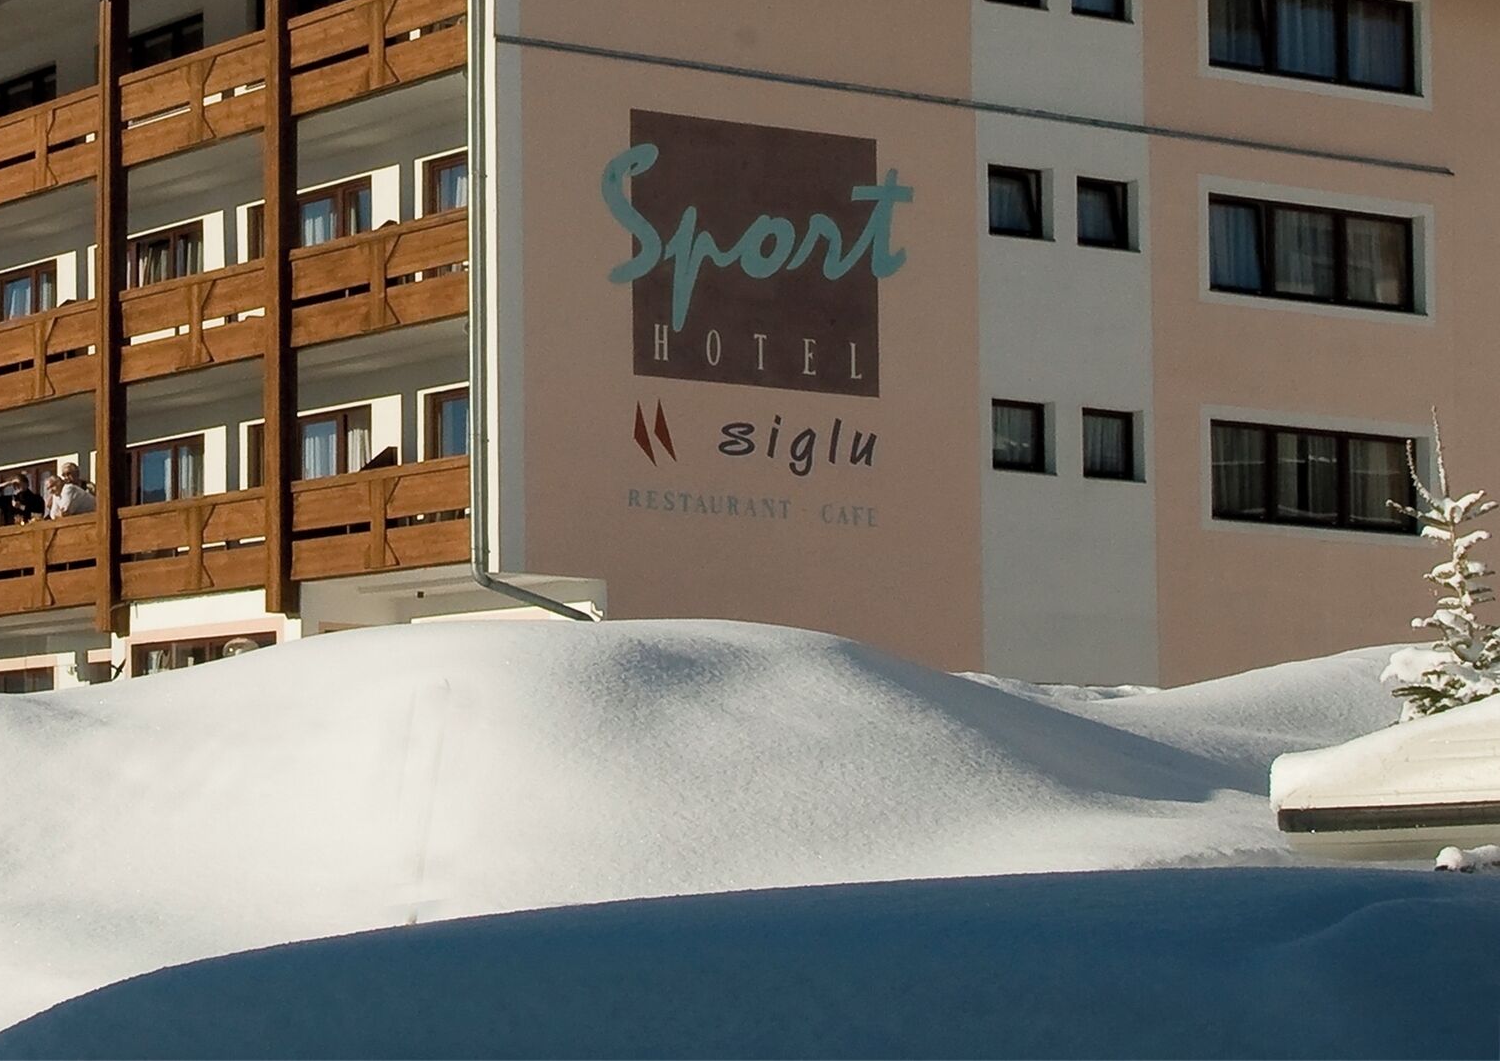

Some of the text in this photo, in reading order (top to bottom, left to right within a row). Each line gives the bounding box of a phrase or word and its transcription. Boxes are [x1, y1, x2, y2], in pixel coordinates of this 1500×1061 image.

[601, 143, 914, 332] Sport
[653, 324, 862, 380] HOTEL
[718, 415, 878, 476] siglu
[628, 489, 878, 527] RESTAURANT CAFE
